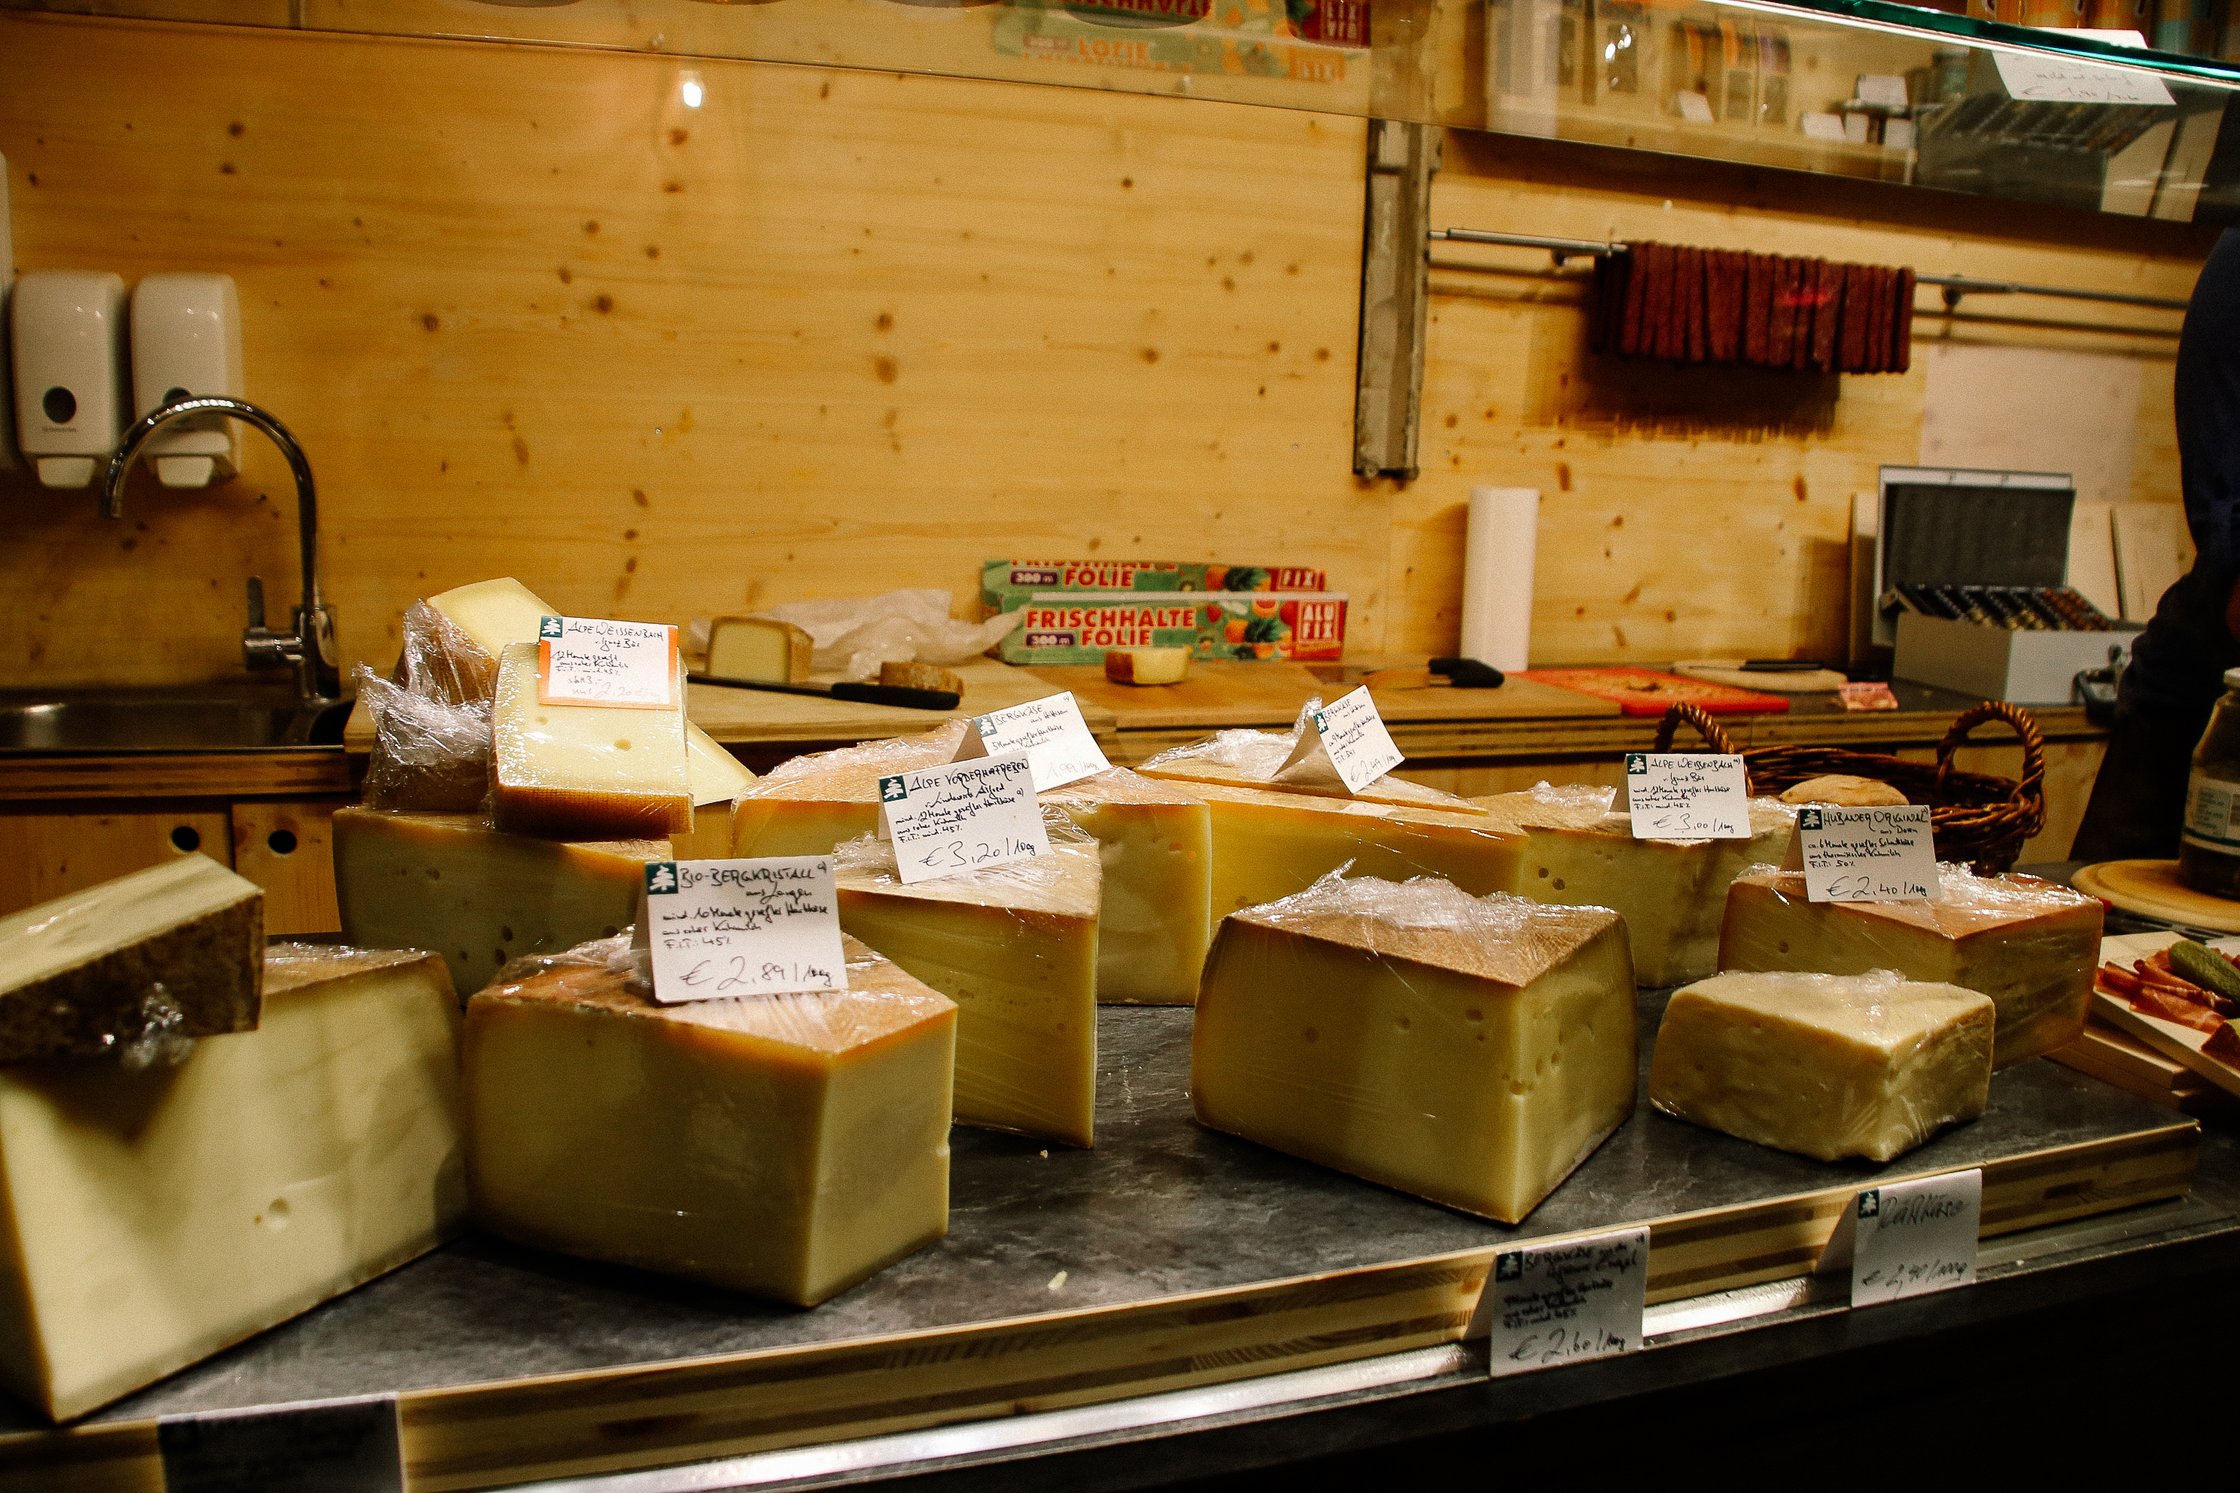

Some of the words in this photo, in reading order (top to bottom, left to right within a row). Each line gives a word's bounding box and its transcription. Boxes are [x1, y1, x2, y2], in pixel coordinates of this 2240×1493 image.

[1064, 569, 1134, 588] FOLIE
[1282, 569, 1315, 587] FIX
[1026, 608, 1195, 629] FRISCHHALTE
[1303, 603, 1335, 621] ALU
[565, 621, 595, 635] ALPE
[1302, 621, 1335, 639] FIX
[1081, 629, 1151, 647] FOLIE
[992, 704, 1043, 725] BERGKÄSE
[1650, 758, 1674, 770] ALPE
[909, 776, 941, 795] ALPE
[1873, 810, 1929, 828] ORIGINAL
[679, 866, 816, 889] BIO-BERGKRISTALL
